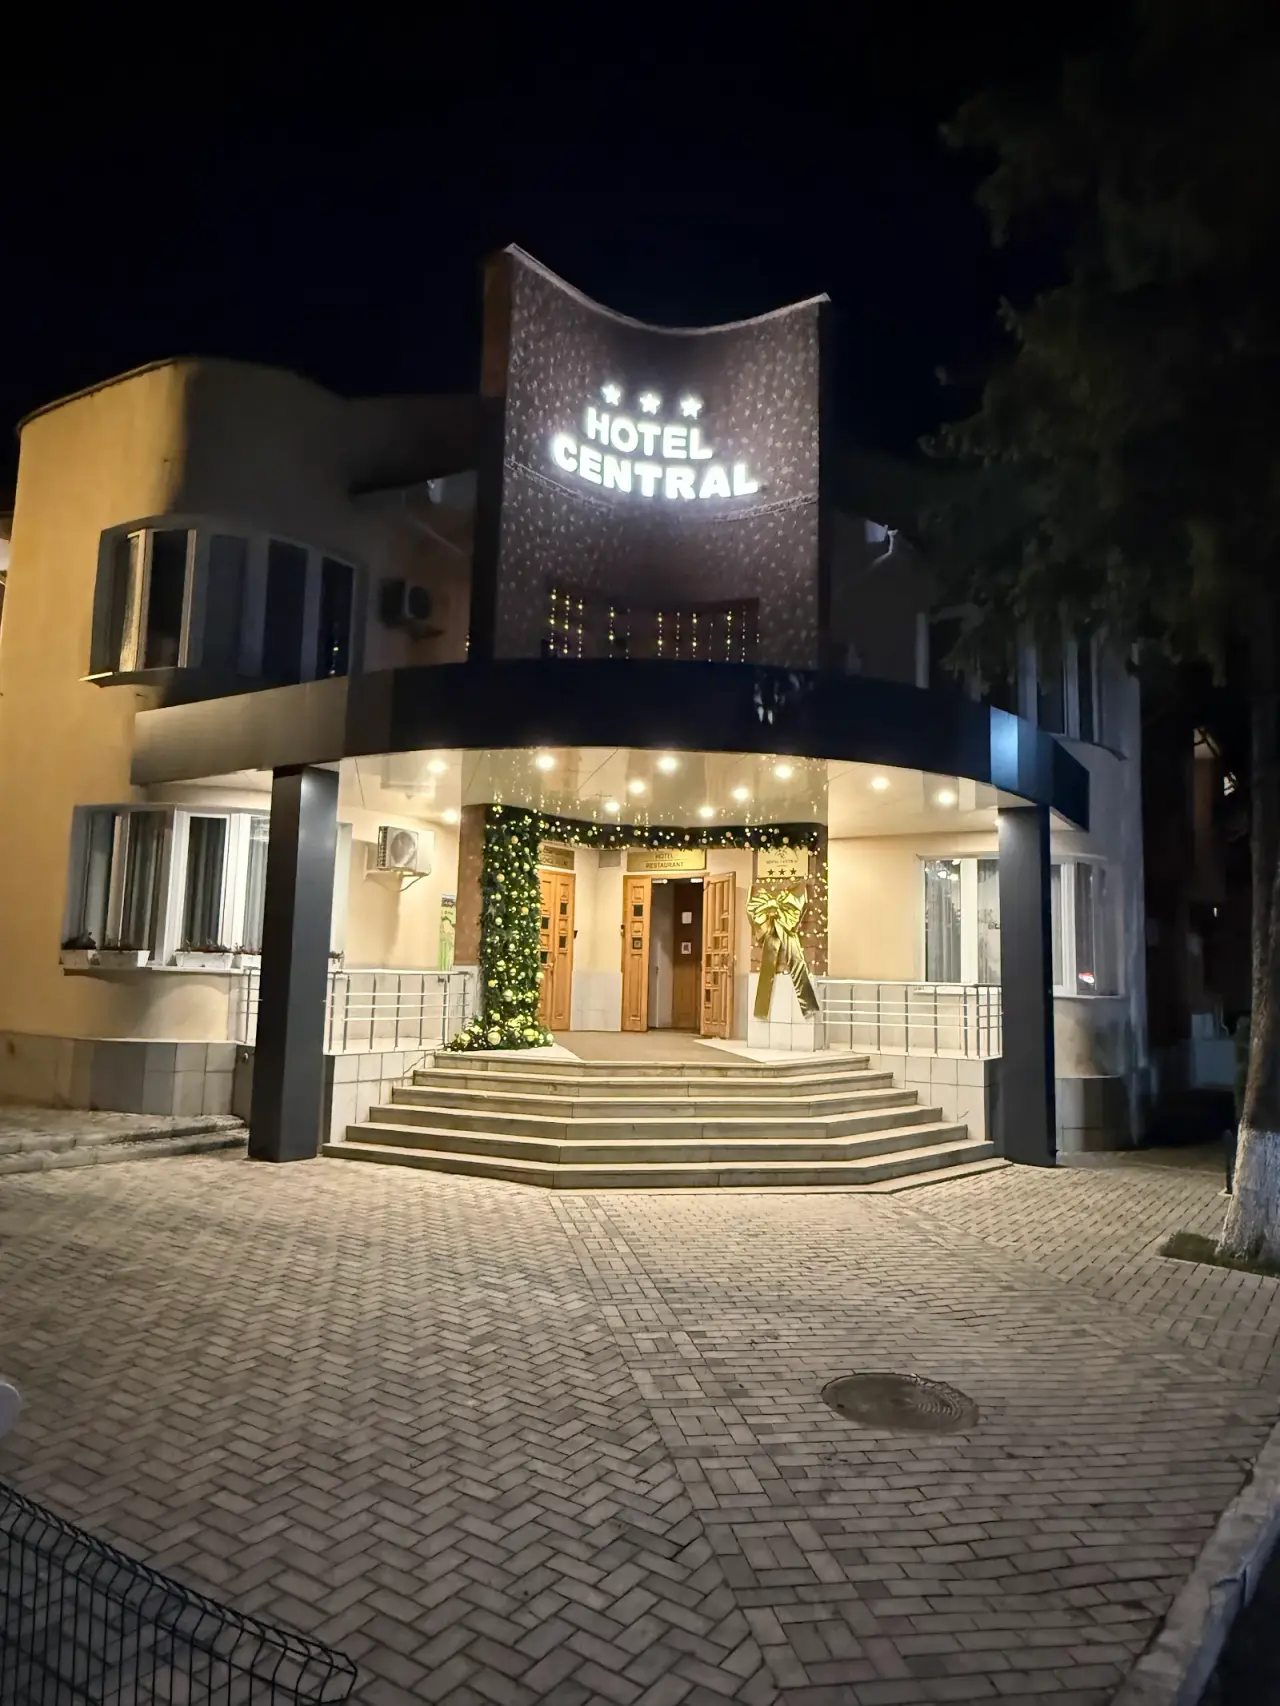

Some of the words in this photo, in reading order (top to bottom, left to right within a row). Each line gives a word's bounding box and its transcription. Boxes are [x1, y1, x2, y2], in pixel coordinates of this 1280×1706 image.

[586, 405, 713, 460] HOTEL
[553, 433, 759, 500] CENTRAL
[645, 861, 684, 869] RESTAURANT
